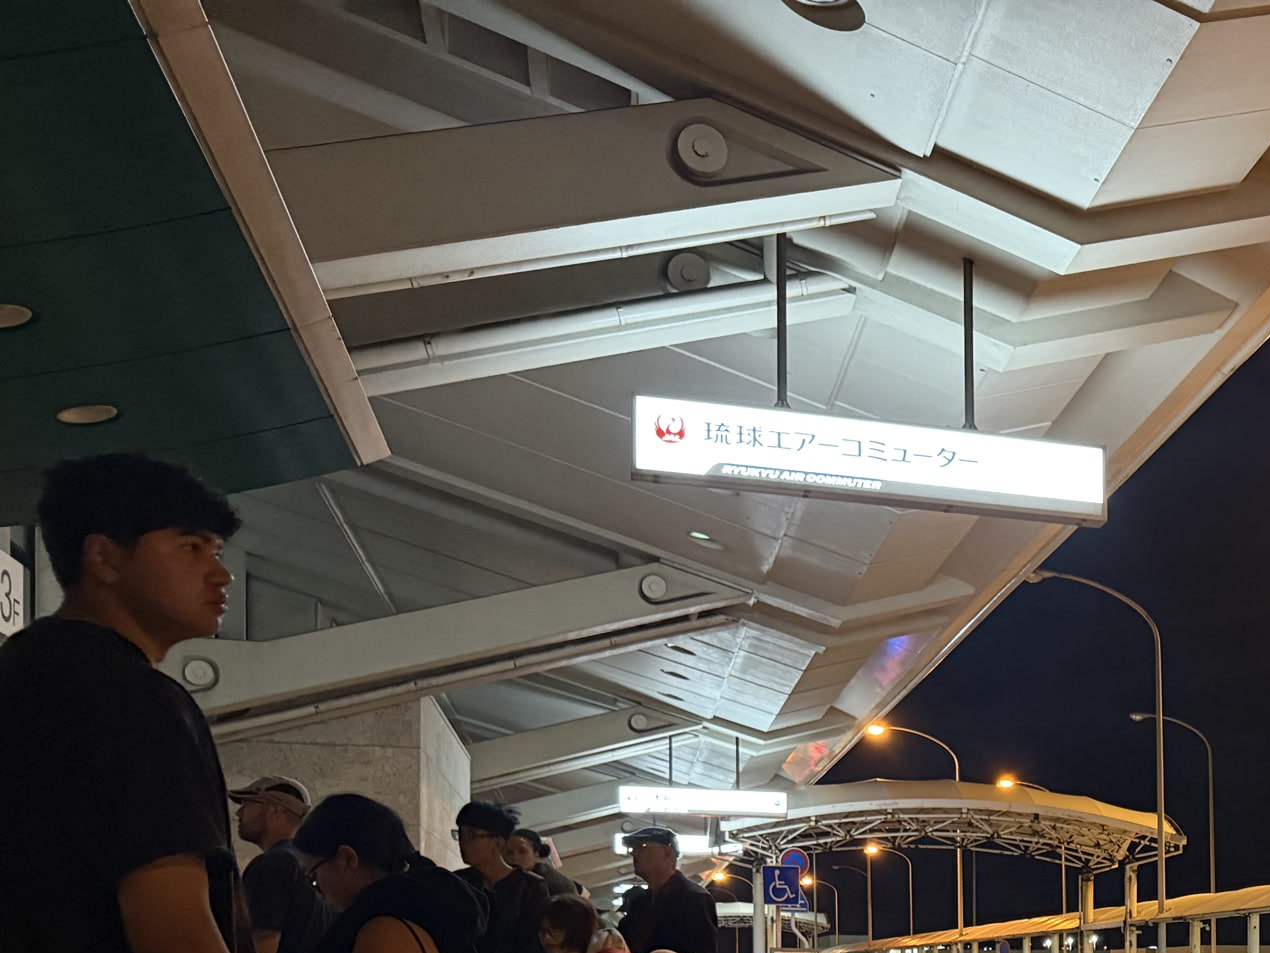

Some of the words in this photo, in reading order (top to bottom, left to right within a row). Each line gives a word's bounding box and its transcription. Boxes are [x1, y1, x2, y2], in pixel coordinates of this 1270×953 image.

[704, 421, 978, 467] 琉球エアーコミューター
[721, 464, 780, 479] RYUKYU
[780, 471, 805, 482] AIR
[806, 474, 883, 490] COMMUTER
